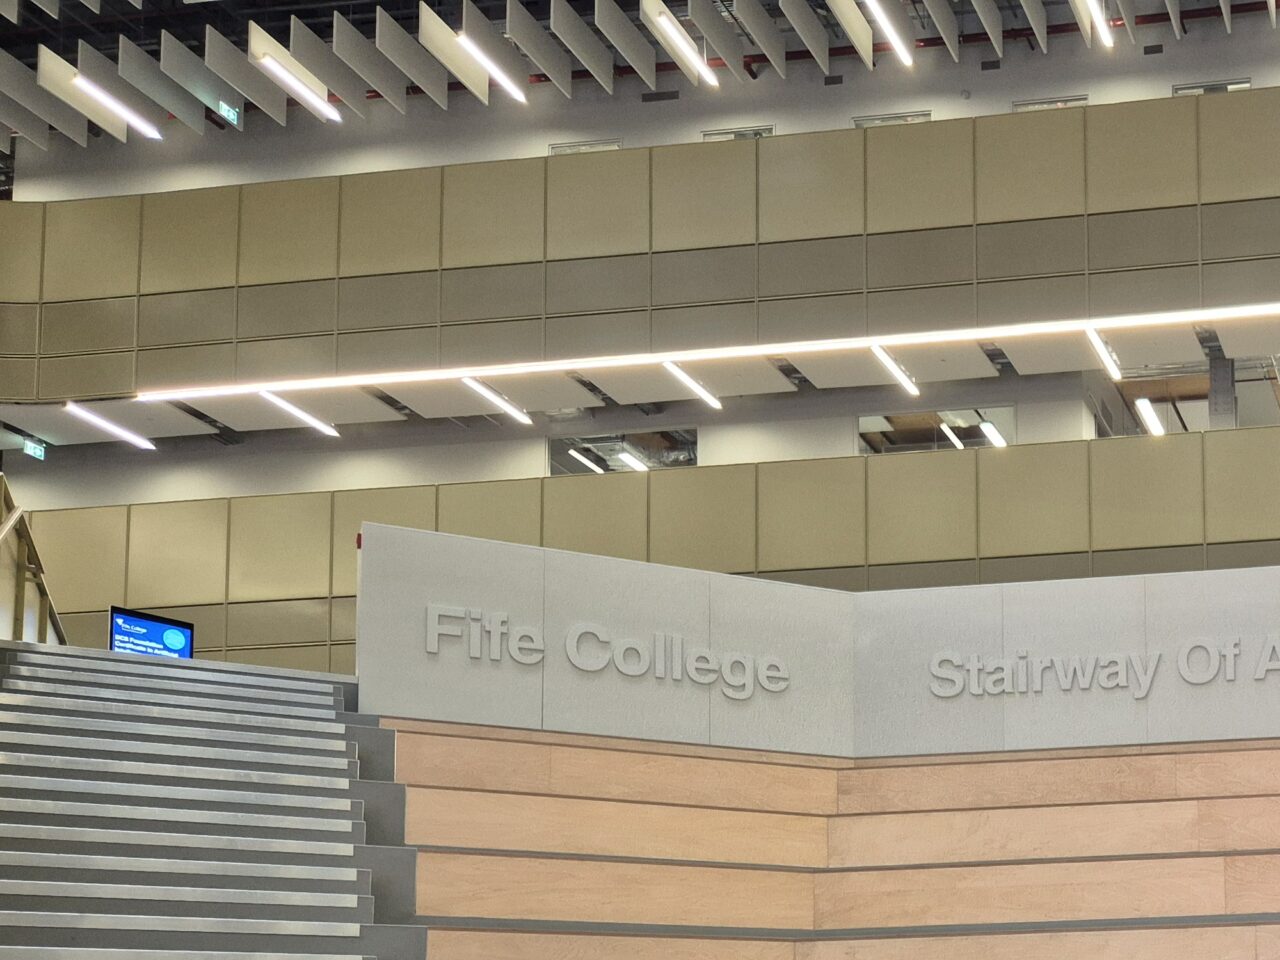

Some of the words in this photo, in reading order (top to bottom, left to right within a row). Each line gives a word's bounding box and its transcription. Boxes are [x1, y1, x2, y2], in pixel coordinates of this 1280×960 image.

[425, 603, 545, 665] Fife
[564, 622, 790, 700] College
[927, 647, 1161, 700] Stairway
[1177, 635, 1241, 685] Of
